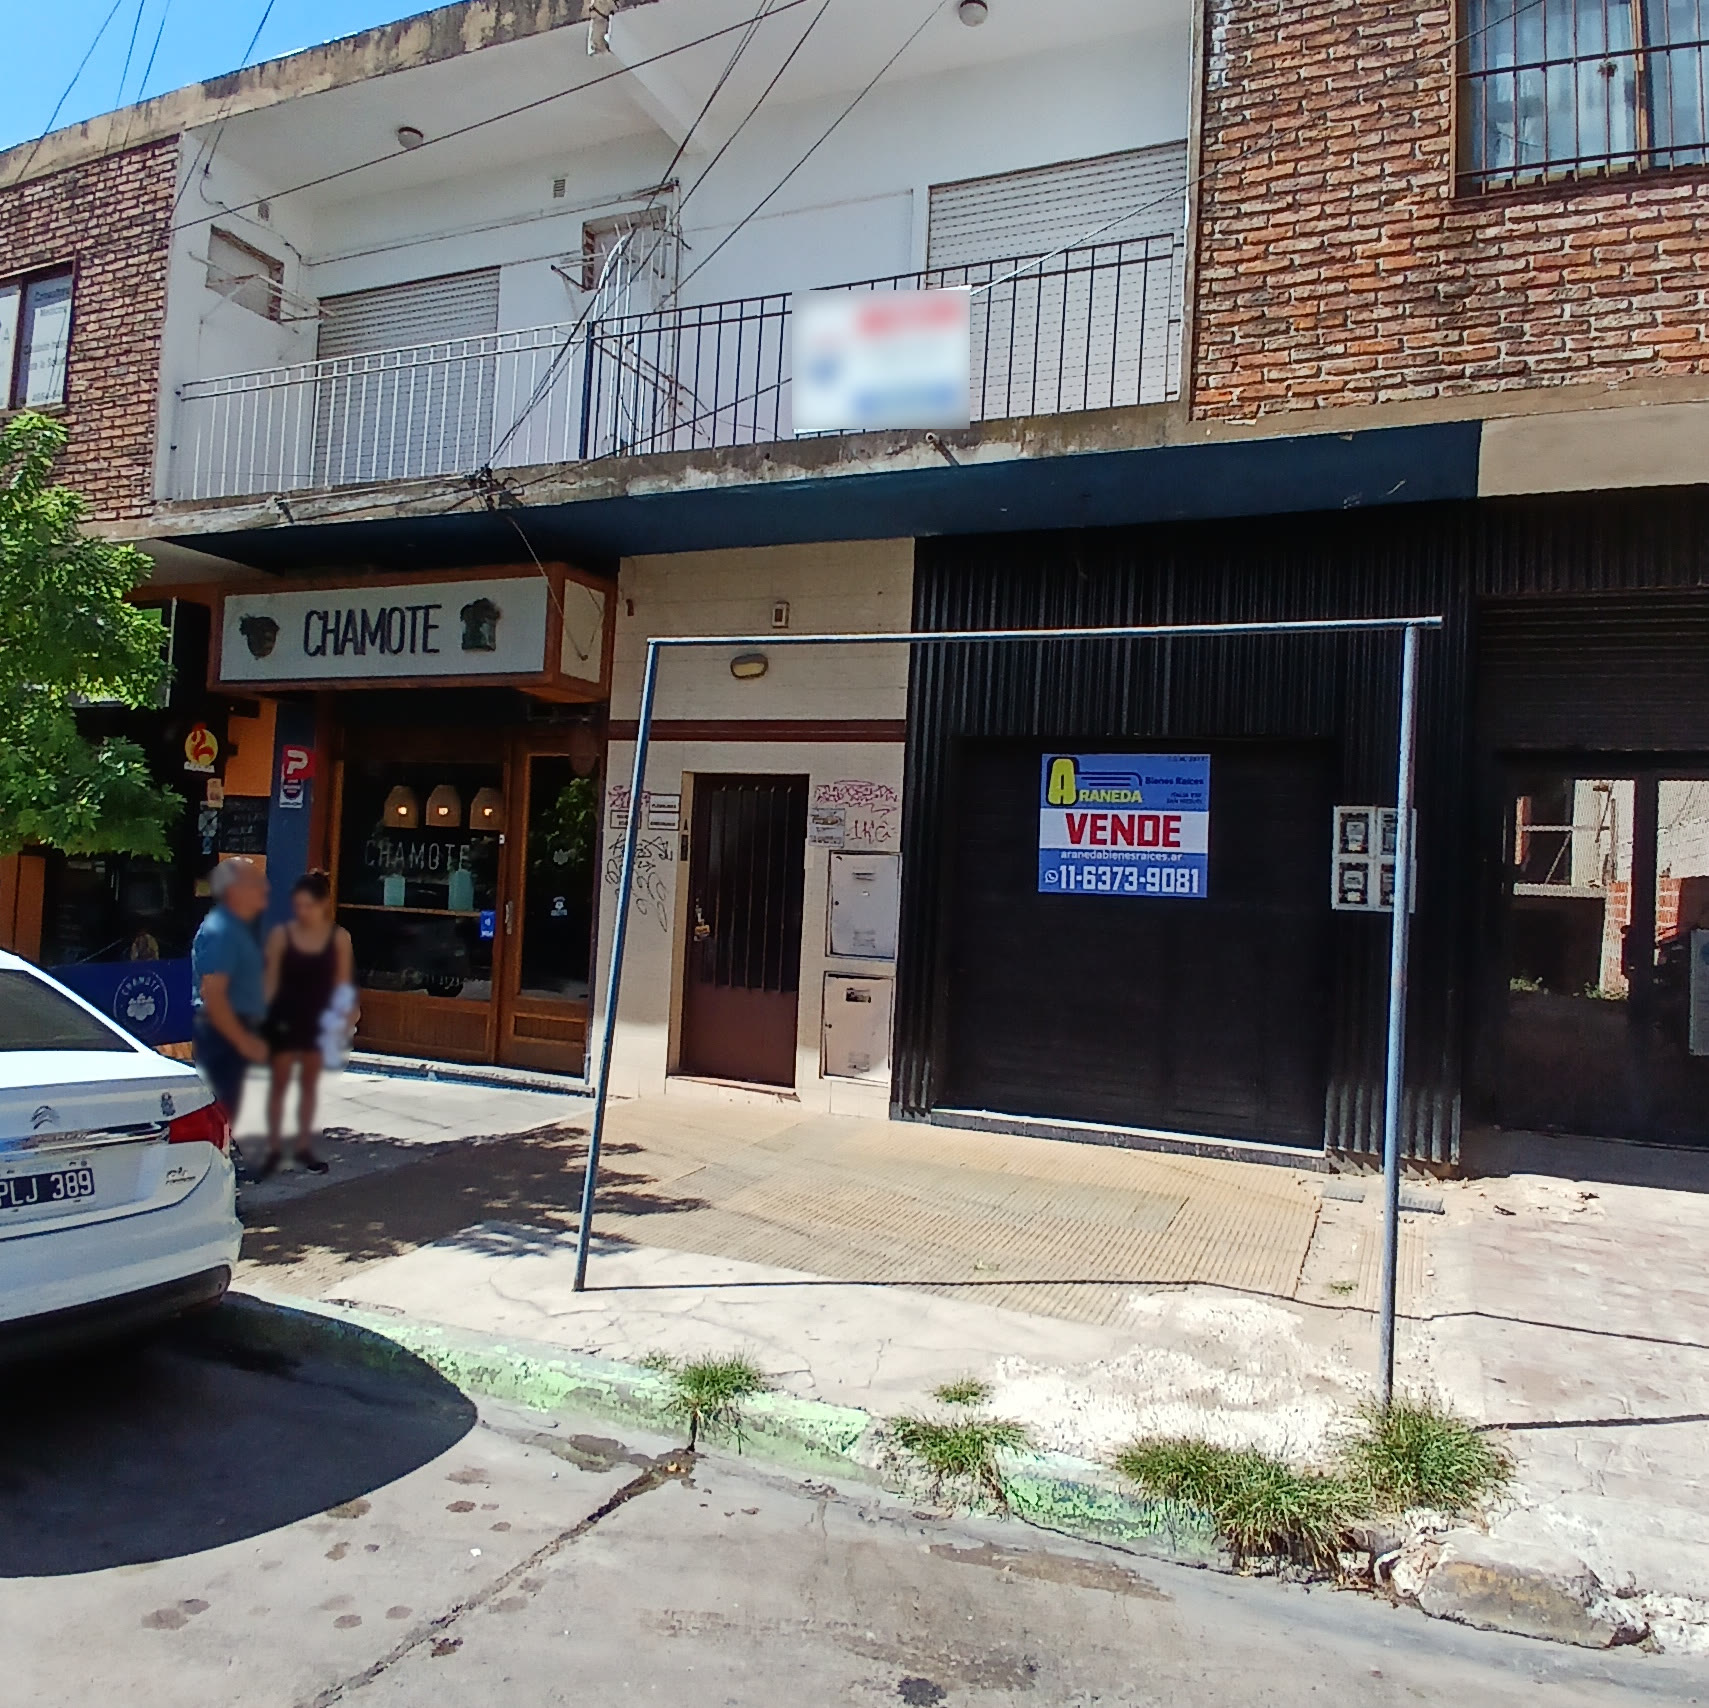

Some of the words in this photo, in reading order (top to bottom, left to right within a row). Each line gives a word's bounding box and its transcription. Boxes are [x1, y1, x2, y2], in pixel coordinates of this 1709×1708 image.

[304, 603, 442, 656] CHAMOTE
[1048, 758, 1142, 805] ARANEDA
[1065, 812, 1182, 848] VENDE
[364, 839, 471, 871] CHAMOTE
[1059, 864, 1199, 894] 11-6373-9081
[0, 1177, 39, 1206] PLJ
[50, 1170, 92, 1200] 389
